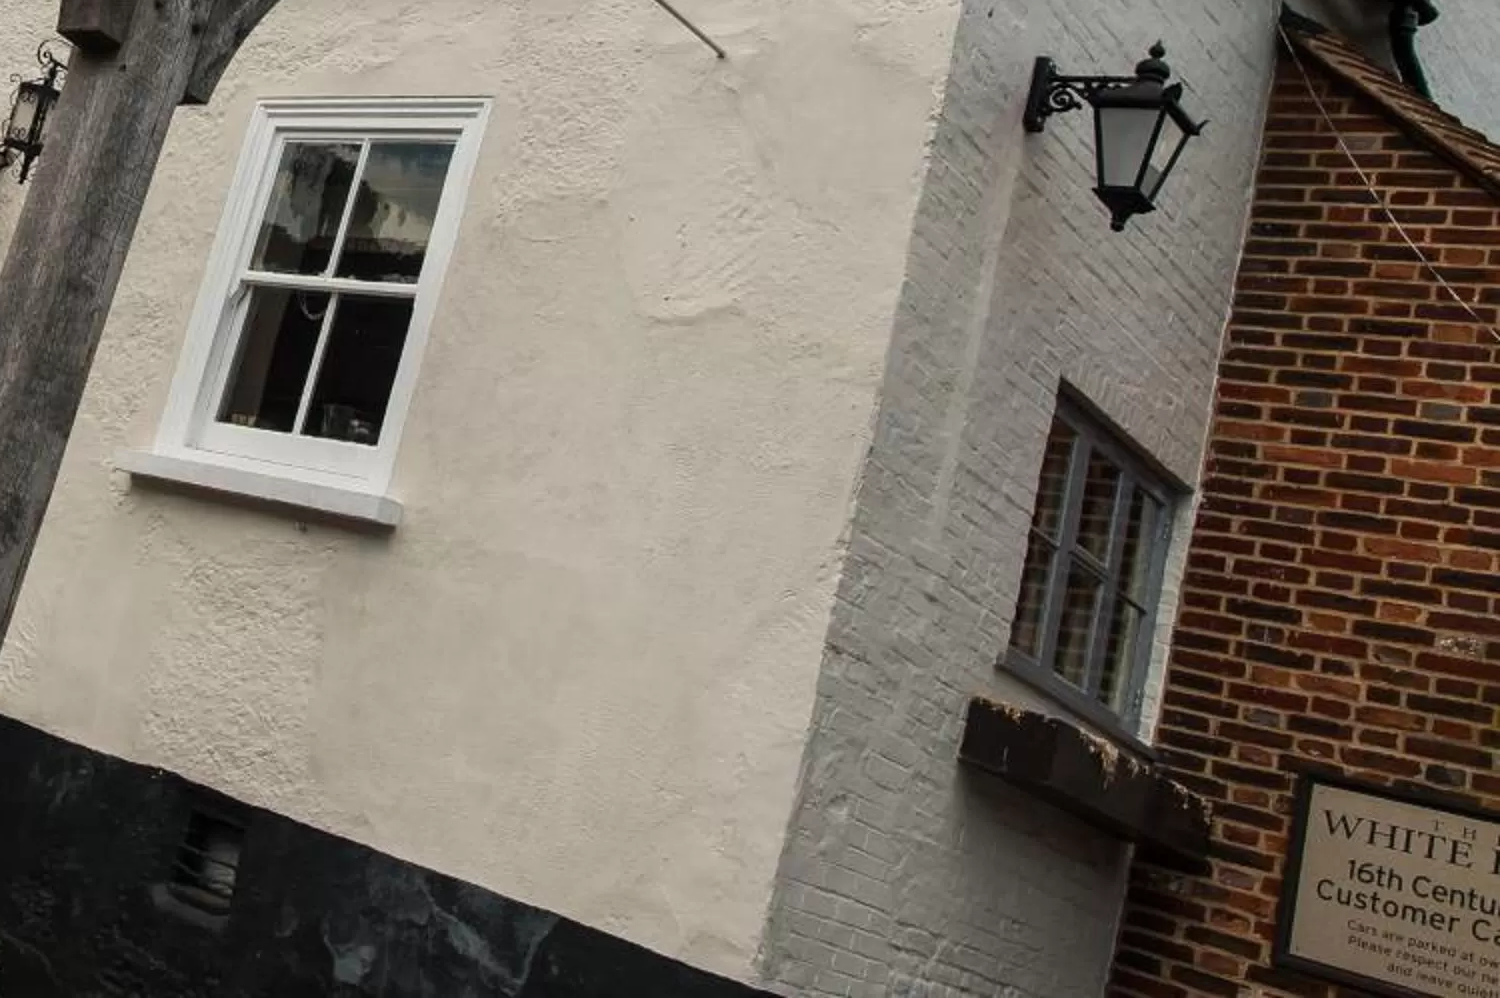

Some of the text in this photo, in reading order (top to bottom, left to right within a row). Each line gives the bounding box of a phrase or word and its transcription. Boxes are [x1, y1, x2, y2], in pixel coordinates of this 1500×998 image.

[1323, 809, 1474, 869] WHITE
[1316, 879, 1461, 933] Customer
[1348, 859, 1500, 918] 16th Centu
